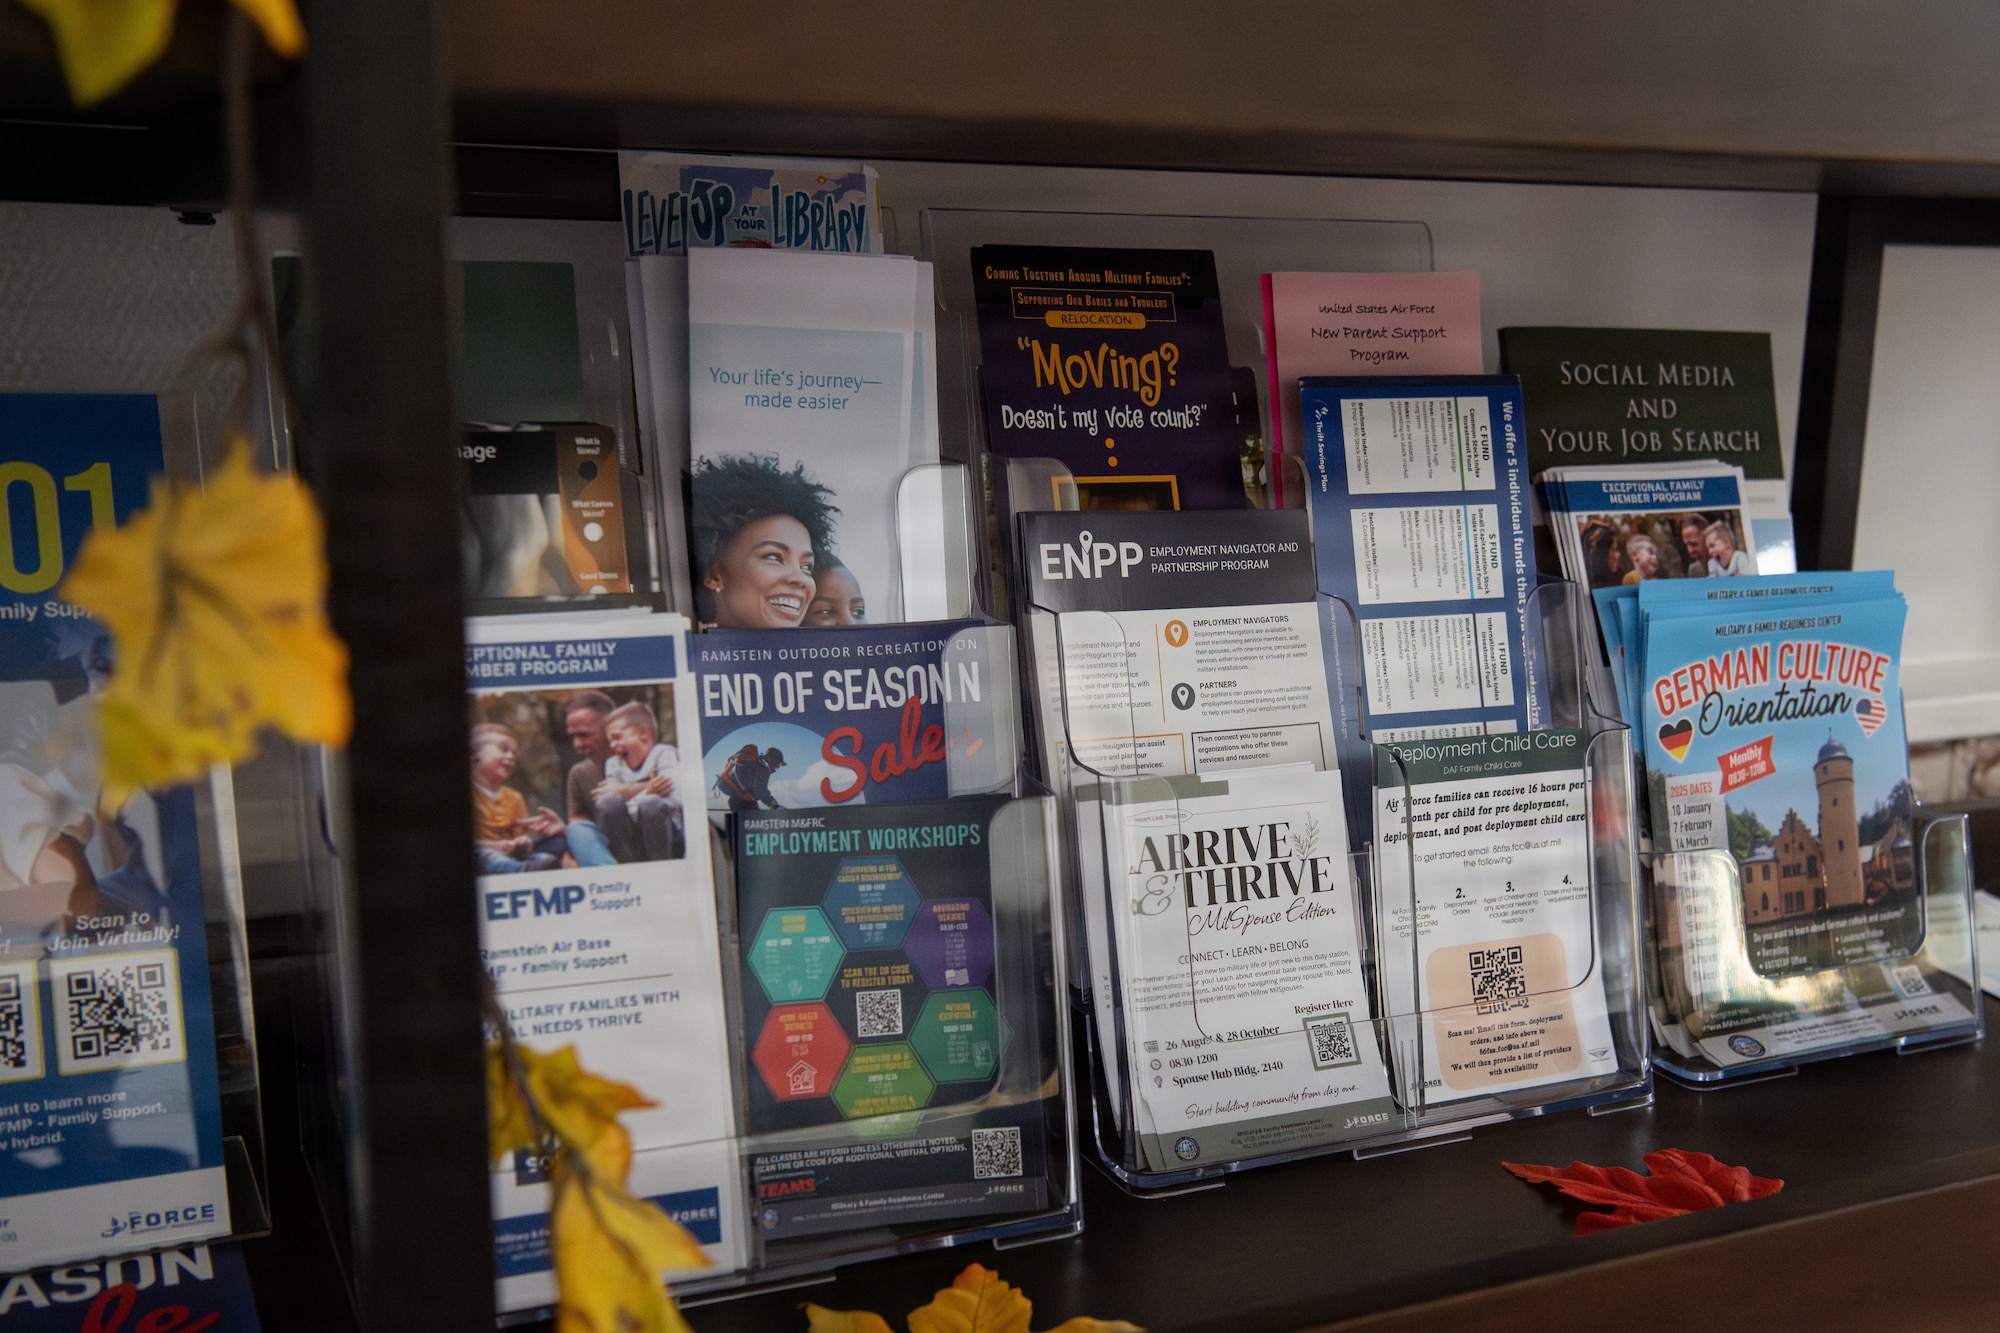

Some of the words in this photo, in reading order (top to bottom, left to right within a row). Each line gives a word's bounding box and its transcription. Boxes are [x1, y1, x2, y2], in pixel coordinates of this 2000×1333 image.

[742, 206, 757, 216] AT
[772, 184, 865, 252] LIBRARY
[734, 218, 766, 230] YOUR
[1319, 304, 1352, 314] United
[1356, 305, 1387, 313] States
[1391, 305, 1407, 313] Air
[1410, 304, 1435, 313] Force
[1061, 315, 1132, 325] RELOCATION
[1311, 327, 1339, 338] New
[1343, 327, 1388, 338] Parent
[1391, 327, 1447, 342] Support
[1350, 349, 1409, 364] Program
[710, 367, 748, 385] Your
[754, 369, 793, 387] life's
[745, 393, 792, 408] made
[798, 394, 849, 409] easier
[1503, 402, 1514, 421] We
[1002, 404, 1067, 430] Doesn't
[1073, 409, 1097, 436] my
[1316, 421, 1324, 442] Thrift
[1505, 424, 1516, 456] offer
[1316, 443, 1326, 473] Savings
[1481, 434, 1490, 461] FUND
[1320, 475, 1328, 492] Plan
[1602, 482, 1668, 492] EXCEPTIONAL
[1670, 480, 1705, 490] FAMILY
[1508, 469, 1522, 535] individual
[1610, 493, 1650, 504] MEMBER
[1652, 491, 1701, 502] PROGRAM
[1040, 542, 1143, 580] ENPP
[1150, 546, 1217, 557] EMPLOYMENT
[1220, 543, 1275, 555] NAVIGATOR
[1278, 543, 1298, 552] AND
[1490, 542, 1498, 569] FUND
[1513, 538, 1525, 575] funds
[1151, 561, 1218, 573] PARTNERSHIP
[1221, 560, 1269, 570] PROGRAM
[1517, 577, 1529, 604] that
[1193, 618, 1241, 627] EMPLOYMENT
[1244, 616, 1289, 624] NAVIGATORS
[1716, 624, 1745, 636] MILITARY
[1754, 622, 1777, 632] FAMILY
[1780, 618, 1815, 630] READINESS
[1818, 615, 1842, 626] CENTER
[556, 643, 617, 657] FAMILY
[702, 649, 772, 662] RAMSTEIN
[779, 647, 850, 661] OUTDOOR
[857, 640, 947, 656] RECREATION
[521, 659, 608, 675] PROGRAM
[1499, 648, 1508, 675] FUND
[703, 673, 763, 717] END
[773, 671, 813, 714] OF
[823, 663, 951, 711] SEASON
[1200, 681, 1237, 689] PARTNERS
[1654, 645, 1769, 717] GERMAN
[1778, 643, 1889, 694] CULTURE
[1699, 680, 1852, 735] Orientation
[1389, 741, 1487, 765] Deployment
[1491, 735, 1531, 753] Child
[1536, 733, 1577, 747] Care
[1729, 745, 1763, 769] Monthly
[1444, 766, 1458, 775] DAF
[1460, 763, 1483, 774] Family
[1484, 761, 1502, 770] Child
[1504, 760, 1522, 769] Care
[1434, 792, 1471, 803] families
[1474, 790, 1490, 798] can
[1493, 787, 1525, 797] receive
[1528, 784, 1538, 793] 16
[1540, 783, 1566, 792] hours
[1569, 782, 1585, 791] per
[1670, 784, 1688, 797] 2025
[1690, 782, 1712, 796] DATES
[1435, 811, 1449, 822] per
[1452, 808, 1475, 817] child
[1478, 806, 1493, 815] for
[1495, 805, 1510, 816] pre
[1513, 799, 1569, 815] deployment,
[1672, 805, 1681, 815] 10
[1684, 802, 1712, 816] January
[745, 820, 789, 830] RAMSTEIN
[791, 818, 825, 828] M&FRC
[1444, 826, 1460, 835] and
[1463, 823, 1482, 836] post
[1485, 818, 1537, 832] deployment
[1540, 815, 1563, 825] child
[1566, 814, 1585, 822] care
[1674, 823, 1678, 832] 7
[1680, 820, 1712, 833] February
[745, 830, 861, 856] EMPLOYMENT
[868, 824, 981, 850] WORKSHOPS
[1128, 822, 1292, 875] ARRIVE
[1676, 838, 1684, 849] 14
[1686, 836, 1709, 847] March
[589, 882, 632, 894] Family
[1132, 874, 1175, 916] &
[1174, 856, 1334, 908] THRIVE
[1506, 882, 1515, 892] 3.
[1563, 875, 1572, 885] 4.
[485, 885, 585, 921] EFMP
[590, 896, 642, 910] Support
[1456, 888, 1465, 898] 2.
[76, 914, 124, 930] Scan
[131, 912, 150, 926] to
[1190, 905, 1282, 936] MilSpouse
[1286, 897, 1336, 922] Edition
[48, 936, 89, 951] Join
[97, 925, 180, 947] Virtually!
[1179, 950, 1224, 965] CONNECT
[1232, 945, 1262, 957] LEARN
[1270, 939, 1309, 952] BELONG
[570, 996, 638, 1013] FAMILIES
[642, 991, 680, 1003] WITH
[1294, 1001, 1330, 1015] Register
[1332, 998, 1354, 1010] Here
[532, 1019, 582, 1035] NEEDS
[589, 1013, 642, 1029] THRIVE
[1165, 1040, 1177, 1050] 26
[1216, 1033, 1223, 1042] &
[1227, 1031, 1238, 1040] 28
[1240, 1025, 1280, 1039] October
[1169, 1053, 1218, 1068] 0830-1200
[1173, 1072, 1209, 1087] Spouse
[1211, 1070, 1232, 1079] Hub
[1233, 1065, 1260, 1077] Bldg.
[1262, 1061, 1283, 1072] 2140
[1185, 1104, 1213, 1119] Start
[1215, 1100, 1249, 1115] building
[1252, 1091, 1299, 1108] community
[1302, 1087, 1321, 1102] from
[1324, 1085, 1340, 1097] day
[1342, 1085, 1359, 1093] one.
[129, 1204, 214, 1229] FORCE
